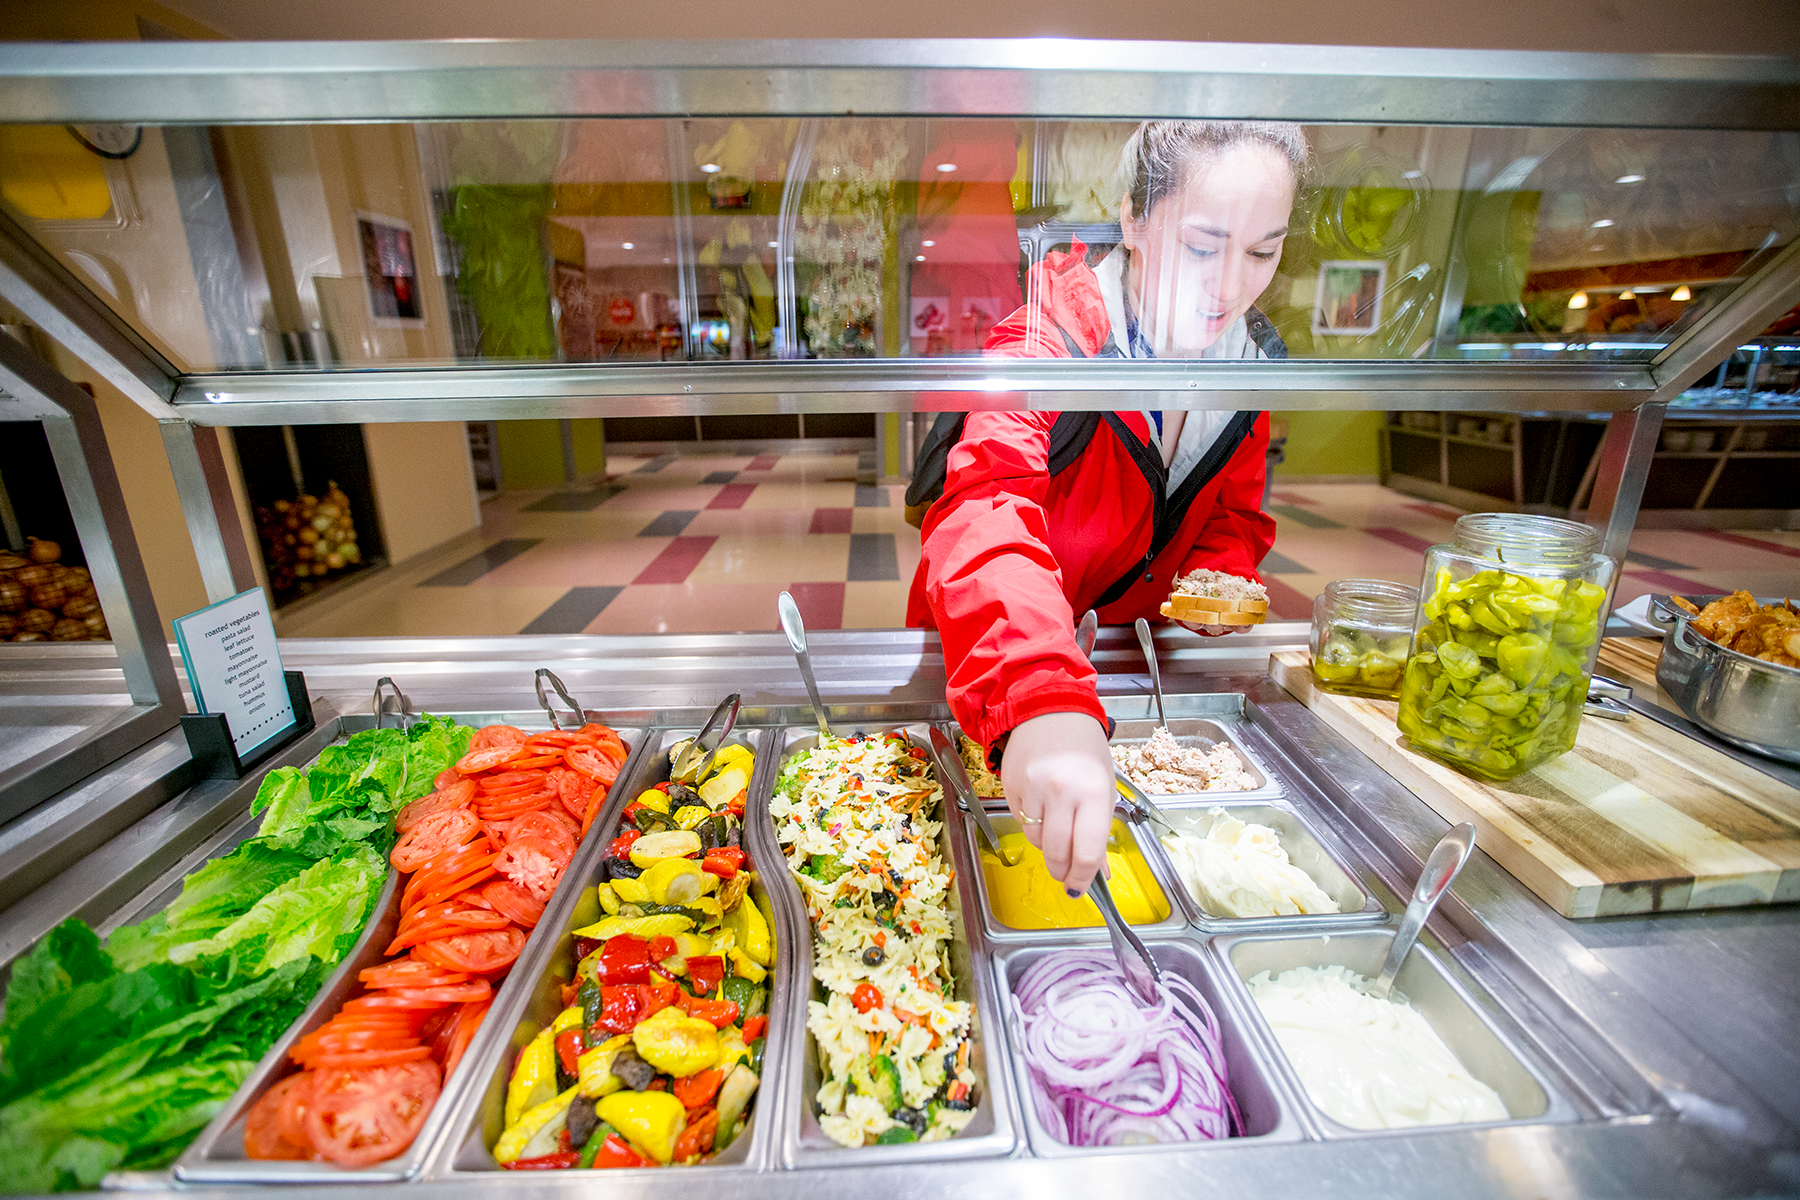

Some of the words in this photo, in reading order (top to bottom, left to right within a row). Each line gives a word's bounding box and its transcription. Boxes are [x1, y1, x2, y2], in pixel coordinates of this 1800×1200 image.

[205, 623, 229, 638] roasted
[229, 610, 260, 626] vegetables
[221, 632, 237, 643] pasta
[237, 625, 251, 635] salad
[224, 642, 235, 652] leaf
[236, 634, 255, 646] lettuce
[229, 646, 254, 660] tomatoes
[227, 654, 258, 672] mayonnaise
[224, 675, 238, 685] light
[238, 660, 268, 678] mayonnaise
[239, 673, 260, 688] mustard
[238, 690, 251, 699] tuna
[252, 681, 266, 692] salad
[243, 692, 266, 706] hummus
[249, 702, 266, 715] onions
